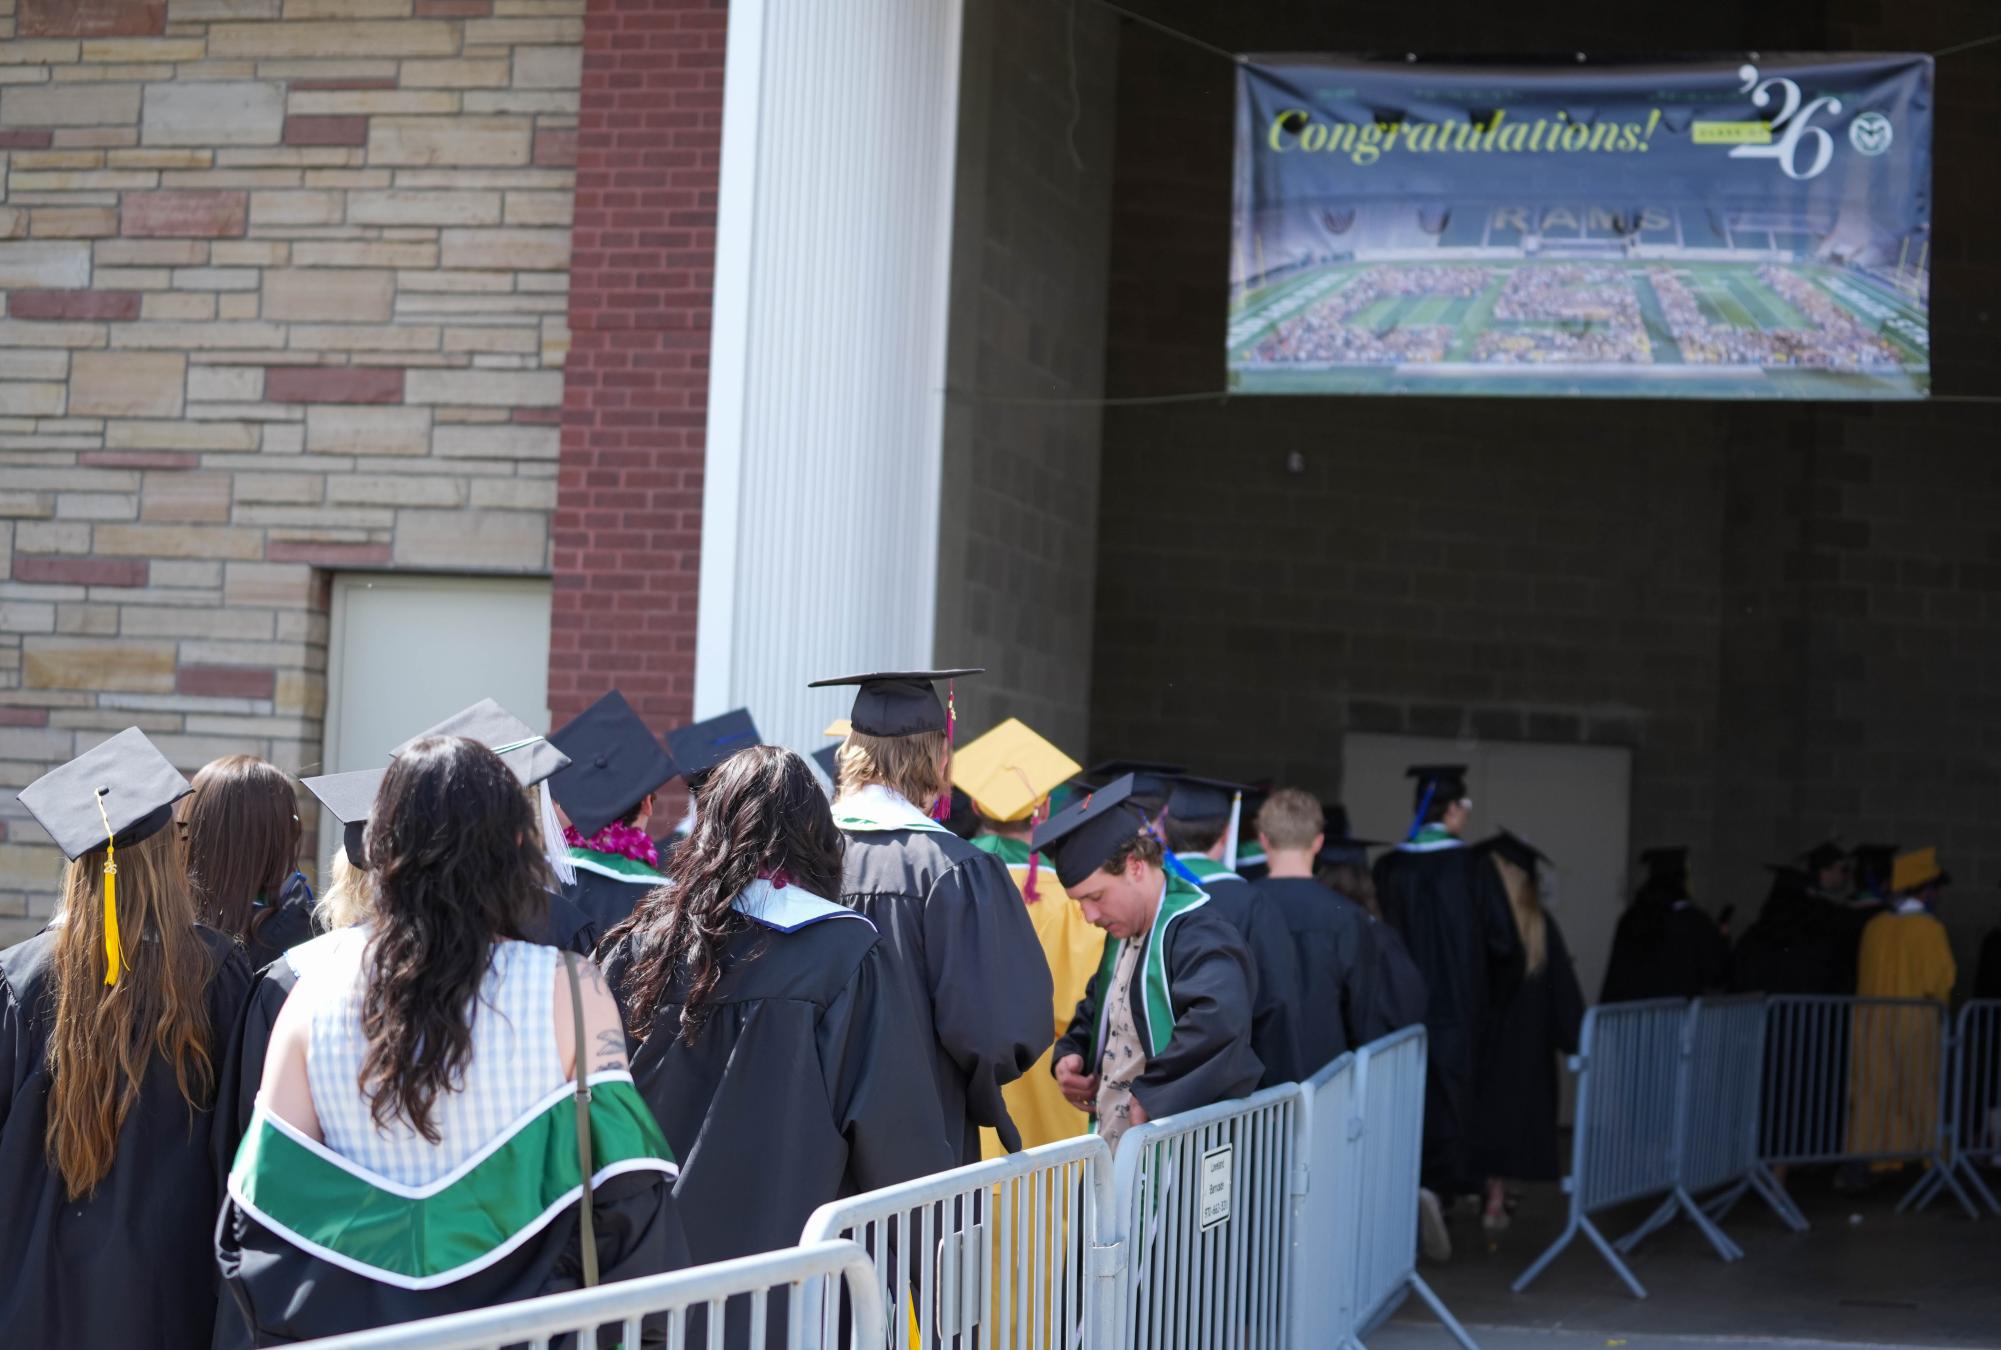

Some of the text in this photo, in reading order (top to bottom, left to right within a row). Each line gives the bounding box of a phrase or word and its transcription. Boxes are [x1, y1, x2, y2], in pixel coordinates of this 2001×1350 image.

[1268, 108, 1661, 166] Congratulations!
[1493, 207, 1671, 233] RAMS
[103, 861, 117, 875] 26
